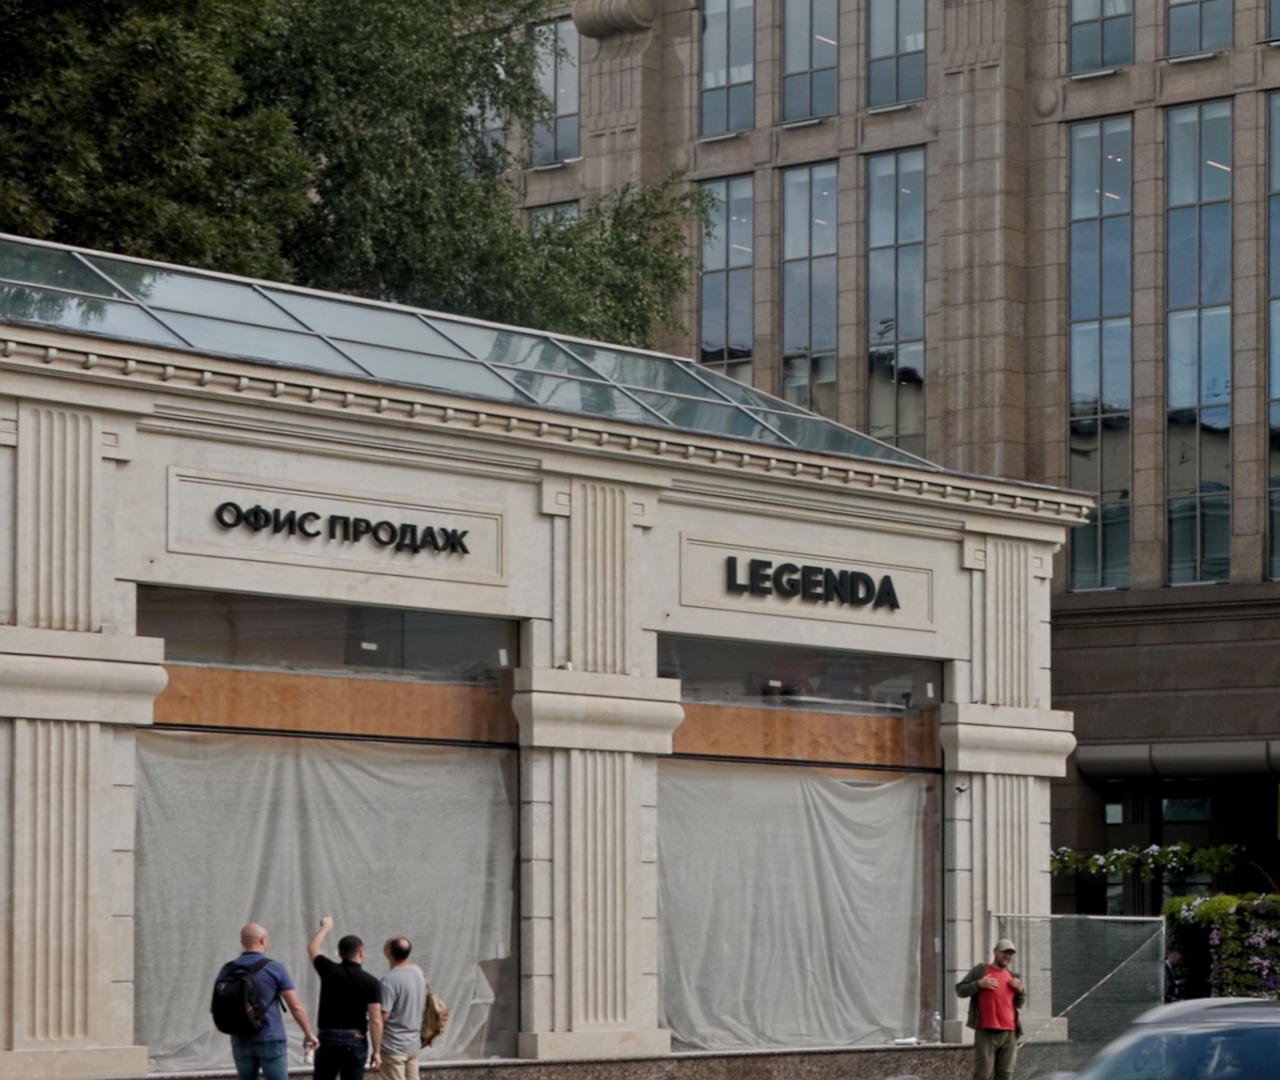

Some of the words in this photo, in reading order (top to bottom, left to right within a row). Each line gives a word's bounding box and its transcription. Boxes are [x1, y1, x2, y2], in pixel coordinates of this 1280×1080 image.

[214, 501, 322, 538] ОФИС
[328, 514, 470, 555] ПРОДАЖ
[726, 555, 901, 610] LEGENDA
